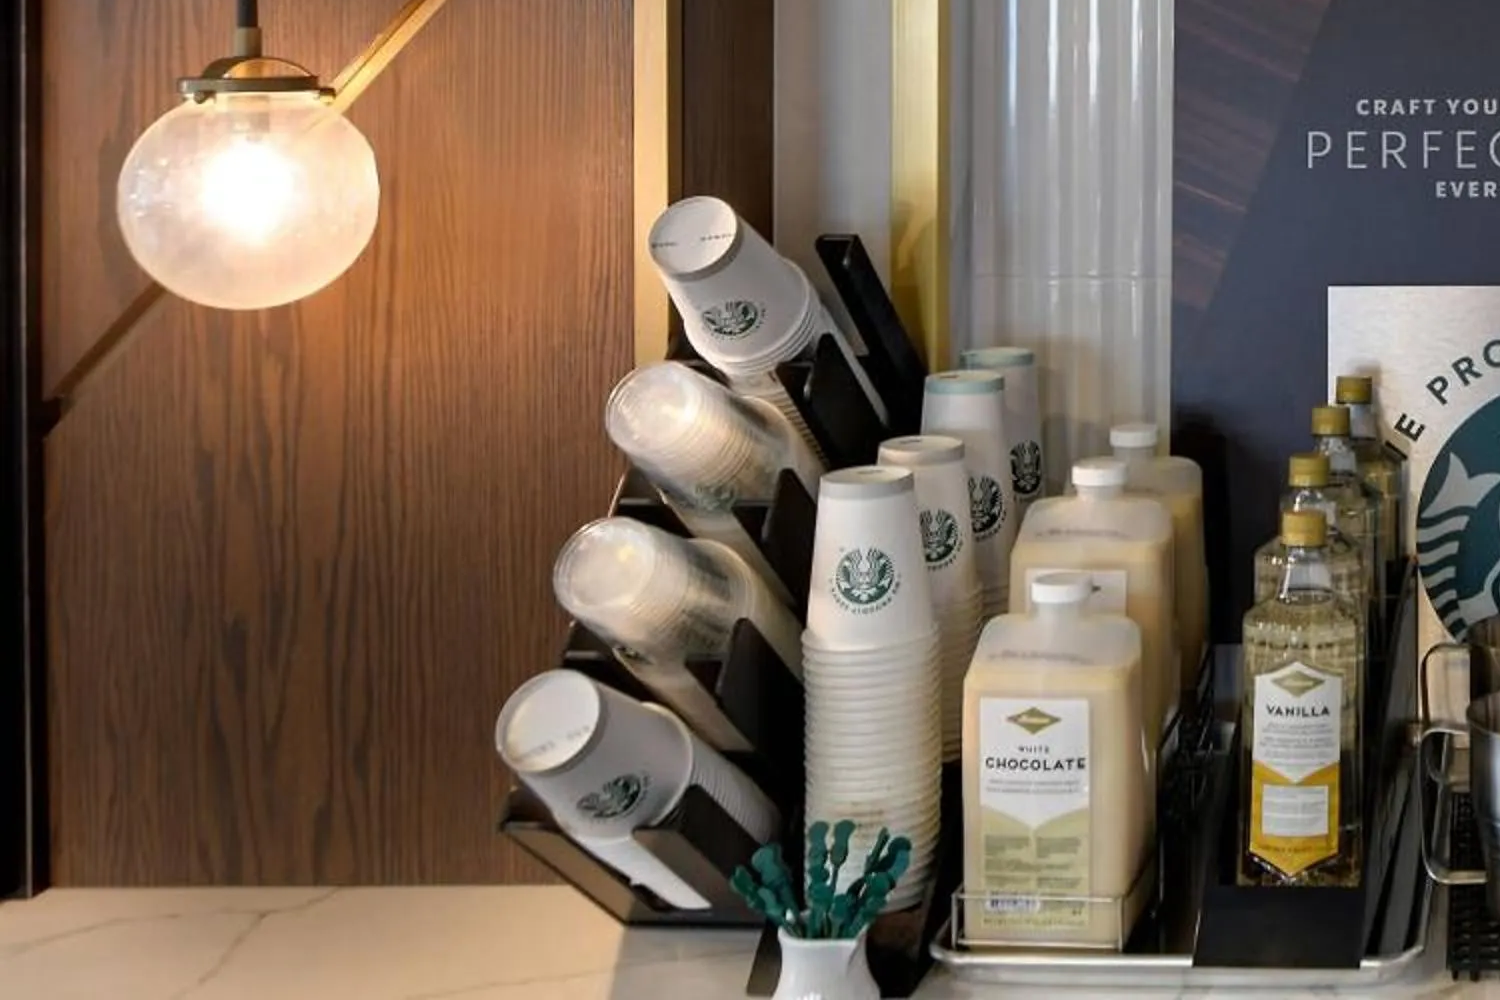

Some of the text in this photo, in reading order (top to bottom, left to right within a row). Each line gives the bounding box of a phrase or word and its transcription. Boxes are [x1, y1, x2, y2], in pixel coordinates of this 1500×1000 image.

[1356, 99, 1437, 116] CRAFT
[1265, 704, 1331, 719] VANILLA
[985, 757, 1087, 771] CHOCOLATE
